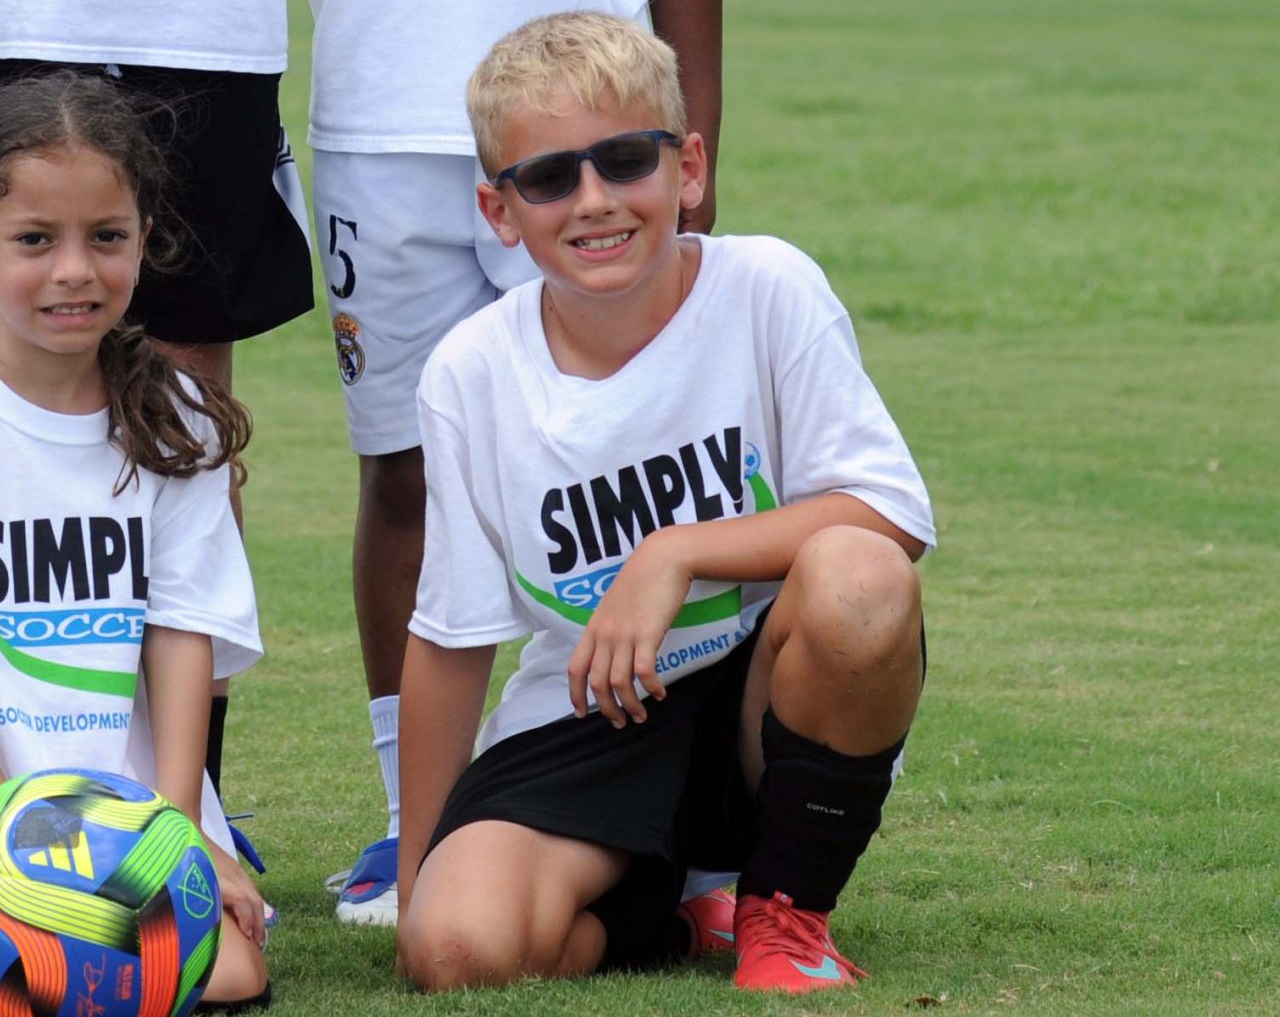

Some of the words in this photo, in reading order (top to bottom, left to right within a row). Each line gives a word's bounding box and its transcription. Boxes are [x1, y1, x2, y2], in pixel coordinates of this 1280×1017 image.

[329, 214, 358, 299] 5
[541, 426, 744, 574] SIMPLY
[654, 633, 730, 674] ELOPMENT
